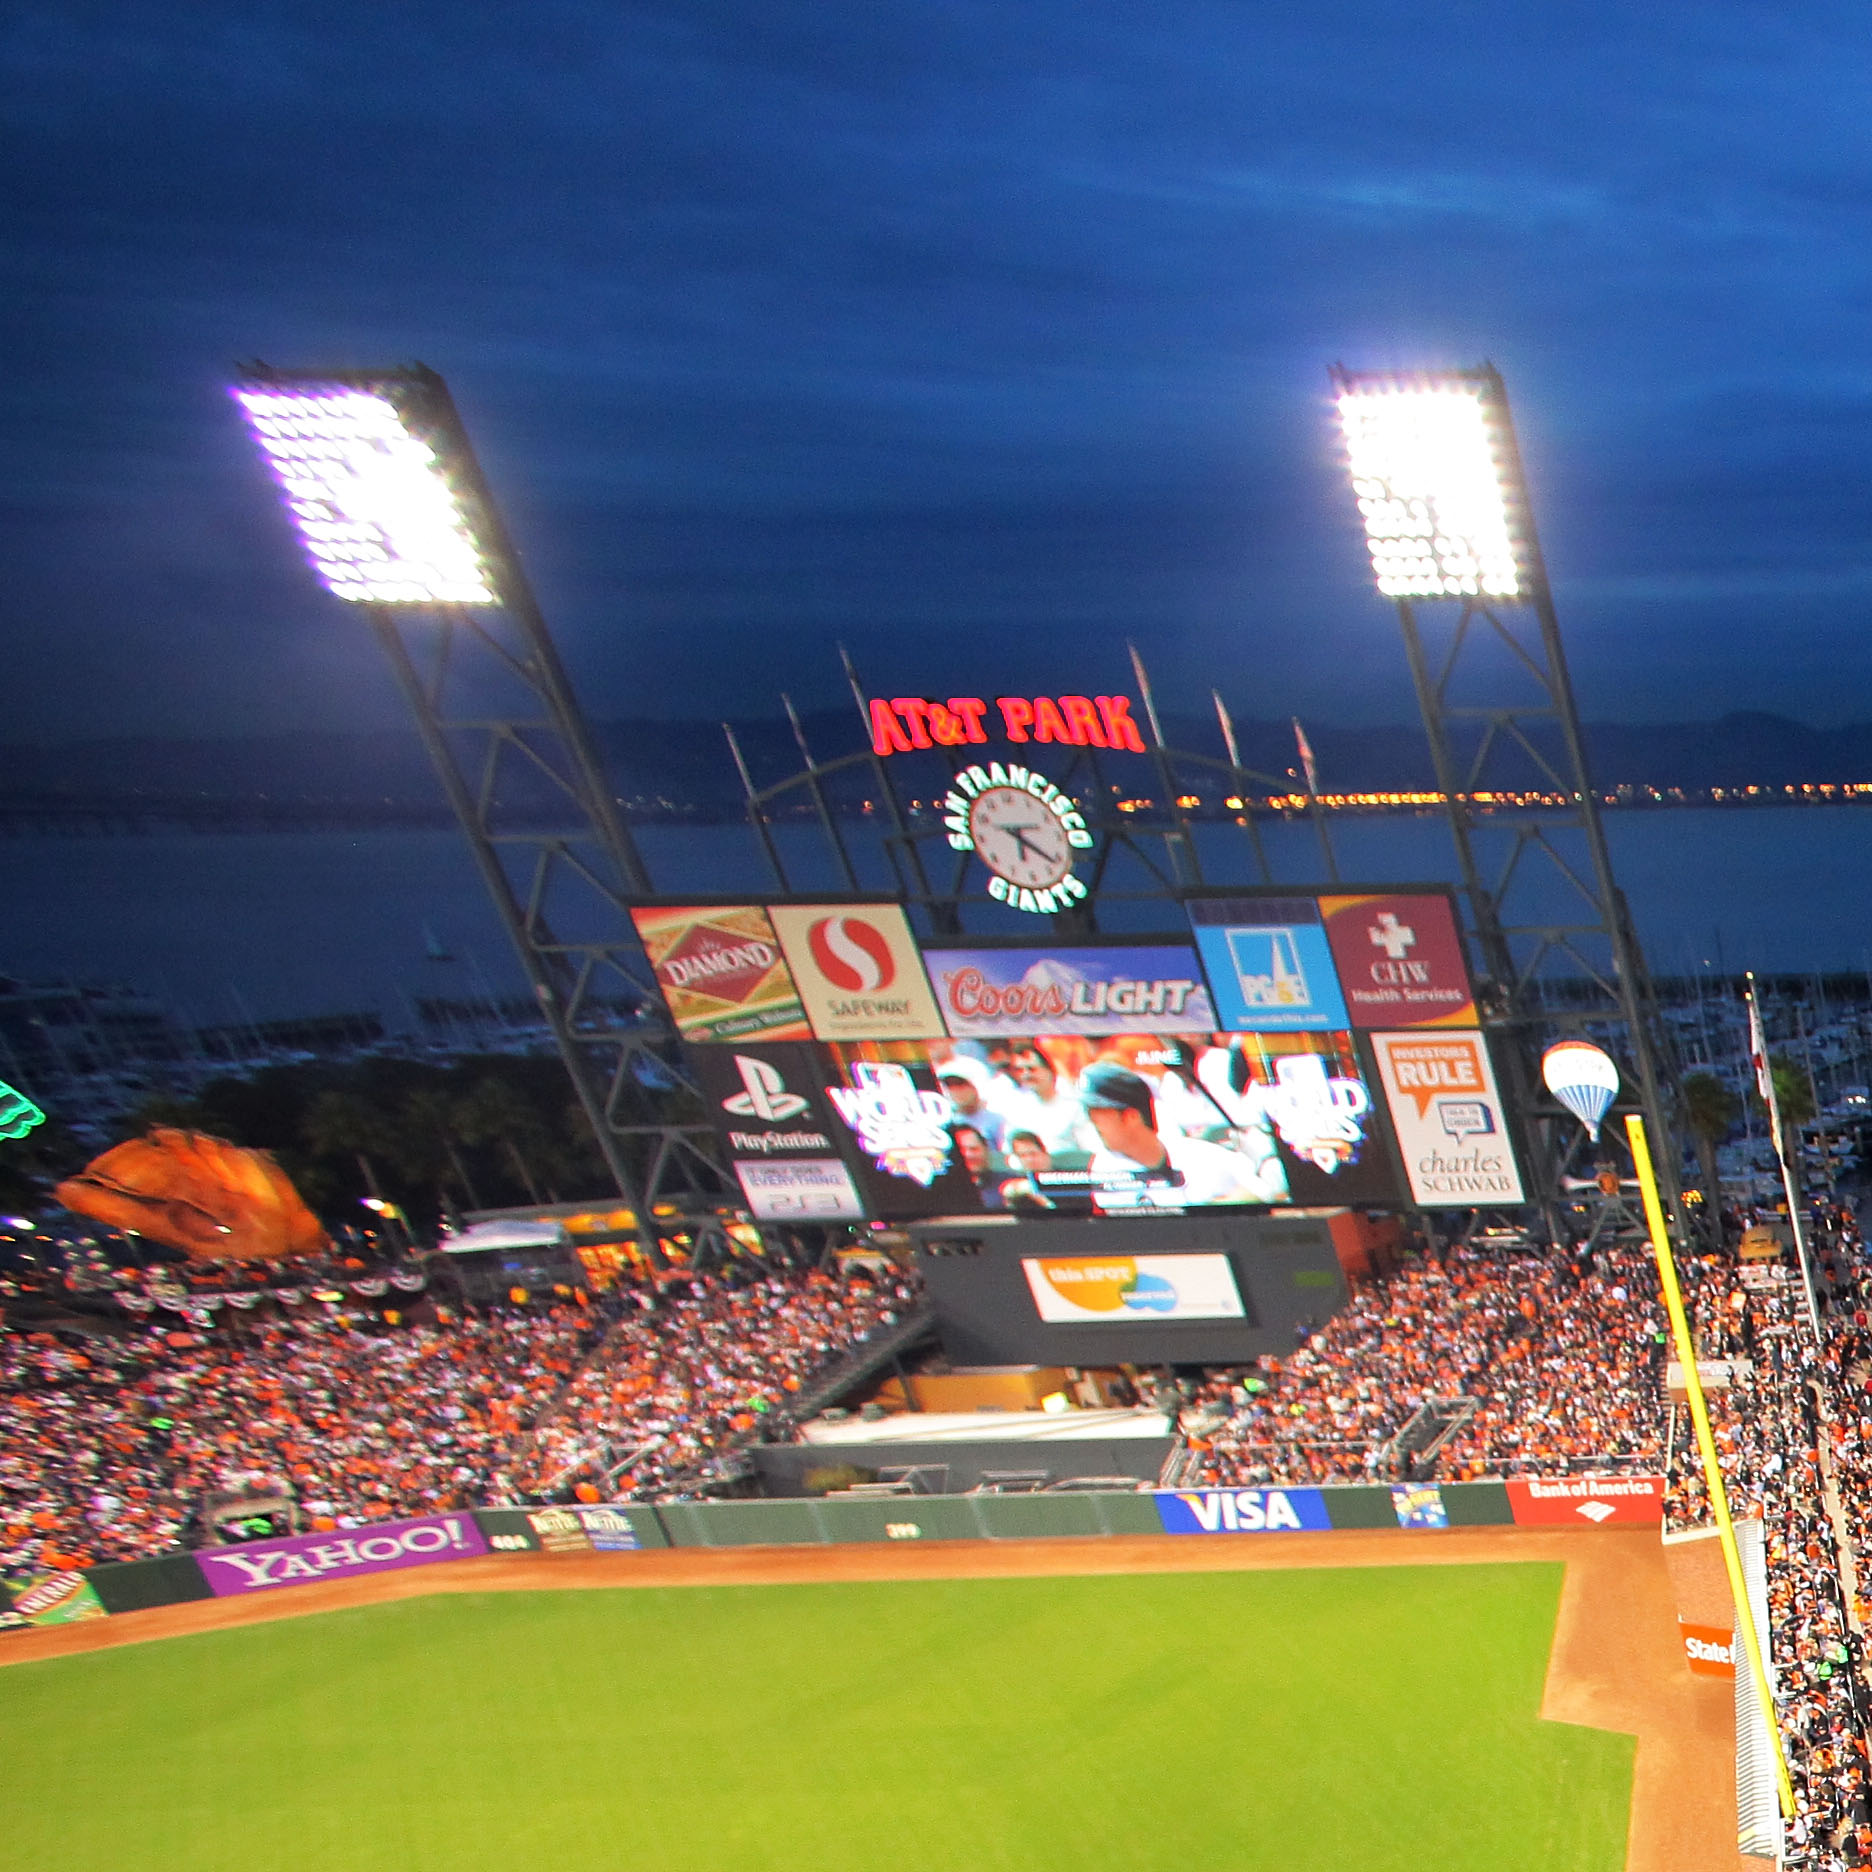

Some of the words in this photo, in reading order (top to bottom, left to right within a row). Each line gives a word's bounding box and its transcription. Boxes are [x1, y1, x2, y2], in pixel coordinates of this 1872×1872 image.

[869, 697, 988, 756] AT&T
[997, 695, 1147, 754] PARK
[955, 761, 1095, 849] FRANCISCO
[943, 790, 976, 851] SAN
[987, 873, 1088, 914] GIANTS
[665, 940, 776, 986] DIAMOND
[1370, 960, 1430, 985] CHW
[942, 965, 1068, 1018] Coors
[1070, 979, 1194, 1015] LIGHT
[1352, 986, 1400, 1002] Health
[1402, 986, 1464, 1002] Services
[825, 999, 912, 1017] SAFEWAY
[1136, 1049, 1182, 1066] JUNE
[1391, 1046, 1471, 1060] INVESTORS
[1397, 1060, 1478, 1087] RULE
[729, 1130, 831, 1154] PlayStation
[1419, 1148, 1503, 1174] charles
[1422, 1176, 1512, 1193] SCHWAB
[1528, 1482, 1572, 1498] Bank
[1570, 1481, 1590, 1497] of
[1588, 1480, 1654, 1496] America
[1176, 1491, 1302, 1531] VISA
[209, 1519, 464, 1587] YAHOO!
[1685, 1637, 1730, 1664] State
